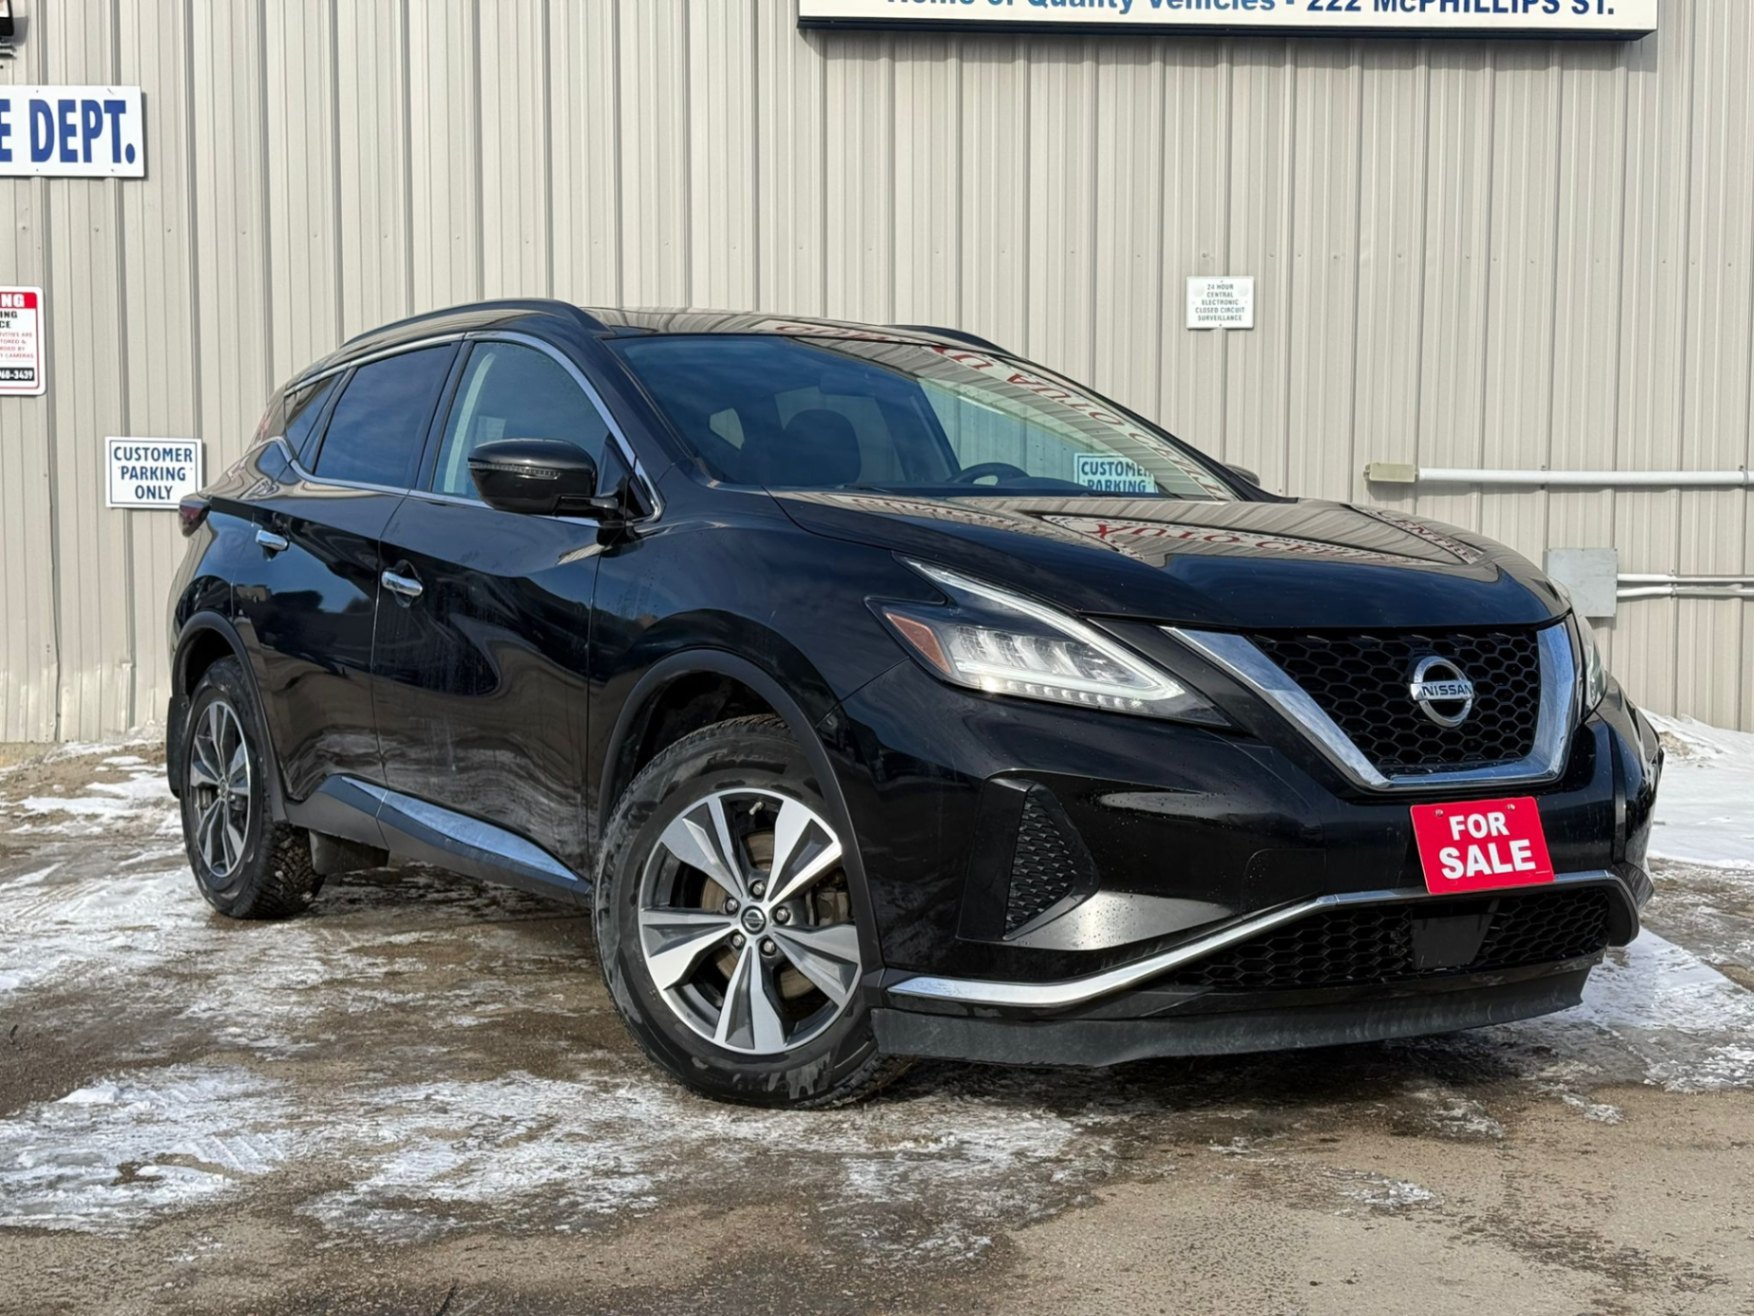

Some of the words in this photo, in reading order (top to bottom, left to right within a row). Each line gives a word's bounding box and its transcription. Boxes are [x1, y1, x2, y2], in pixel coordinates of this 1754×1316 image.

[1307, 0, 1362, 12] 222
[29, 99, 136, 165] DEPT.
[113, 446, 193, 462] CUSTOMER
[120, 465, 187, 481] PARKING
[1081, 460, 1150, 477] CUSTOME
[134, 485, 173, 500] ONLY
[1421, 684, 1473, 697] NISSAN
[1449, 811, 1511, 841] FOR
[1439, 839, 1537, 880] SALE
